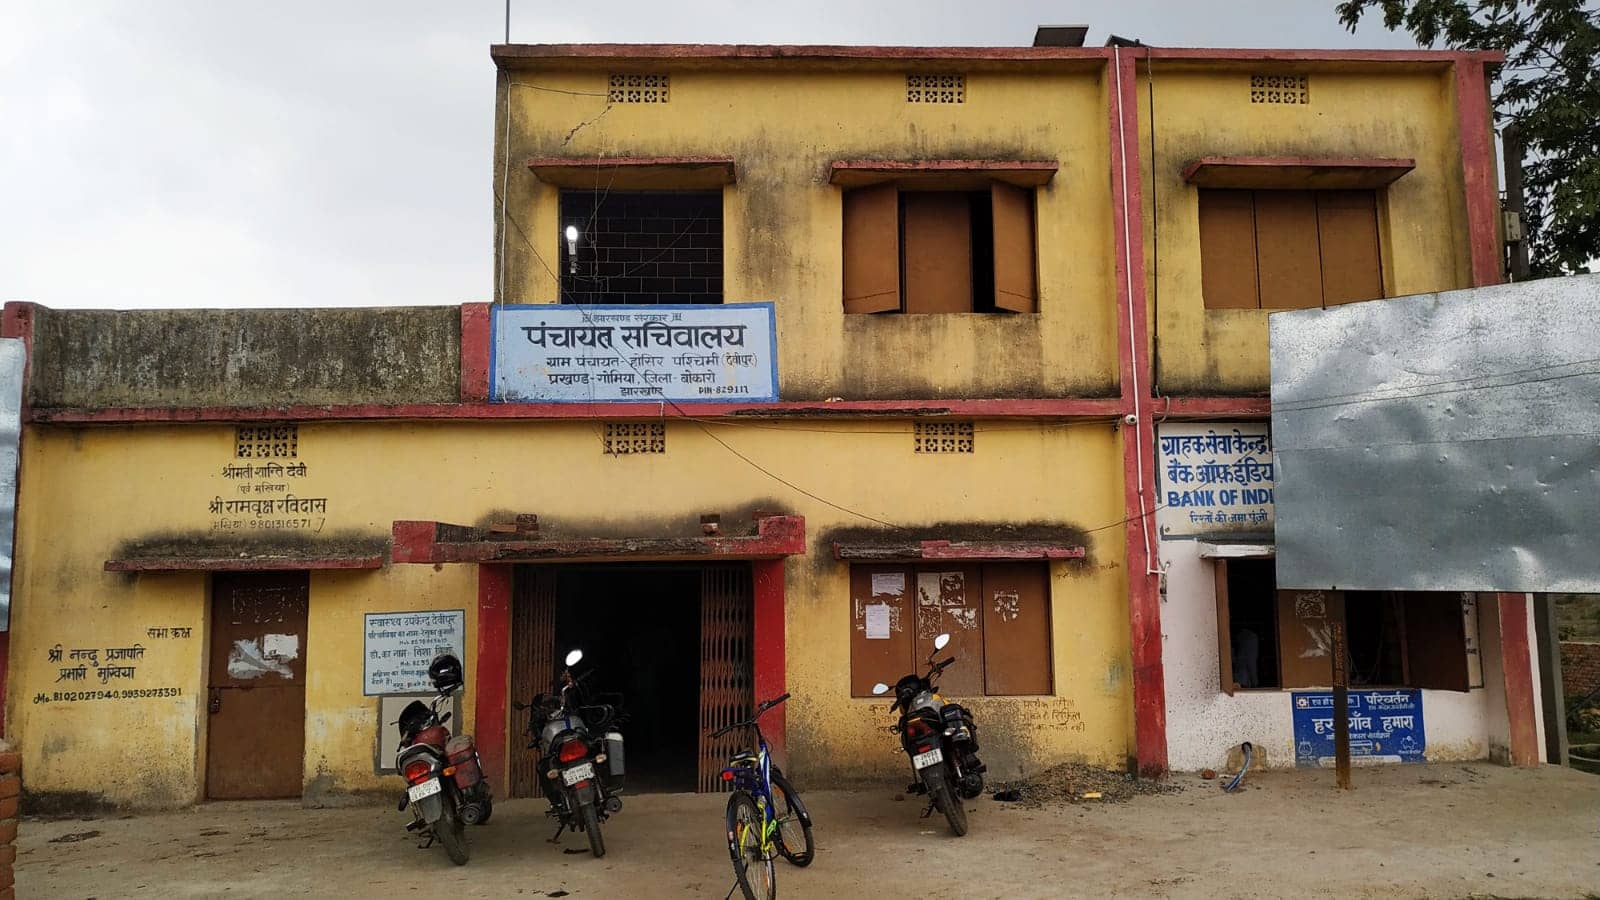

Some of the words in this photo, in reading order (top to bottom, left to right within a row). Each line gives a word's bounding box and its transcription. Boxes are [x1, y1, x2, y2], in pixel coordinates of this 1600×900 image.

[633, 313, 669, 322] सरकार
[521, 320, 615, 349] पंचायत
[620, 320, 748, 349] सचिवालय
[547, 356, 571, 368] ग्राम
[672, 352, 719, 368] पश्चिमी
[681, 368, 716, 384] बोकारो
[221, 462, 253, 480] श्रीमती
[254, 462, 284, 478] शान्ति
[286, 461, 307, 478] देवी
[1167, 458, 1195, 484] बैंक
[1232, 456, 1274, 486] इंडिय
[208, 495, 223, 514] श्री
[225, 498, 275, 519] रामवृक्ष
[276, 493, 328, 514] रविदास
[1167, 489, 1216, 507] BANK
[1219, 489, 1239, 506] OF
[1241, 488, 1275, 505] INDI
[170, 626, 193, 640] कक्ष
[48, 643, 64, 663] श्री
[105, 643, 146, 661] प्रजापति
[55, 664, 88, 683] प्रभारी
[97, 664, 136, 684] मुखिया
[1364, 690, 1410, 706] परिवर्तन
[1380, 715, 1414, 734] हमारा
